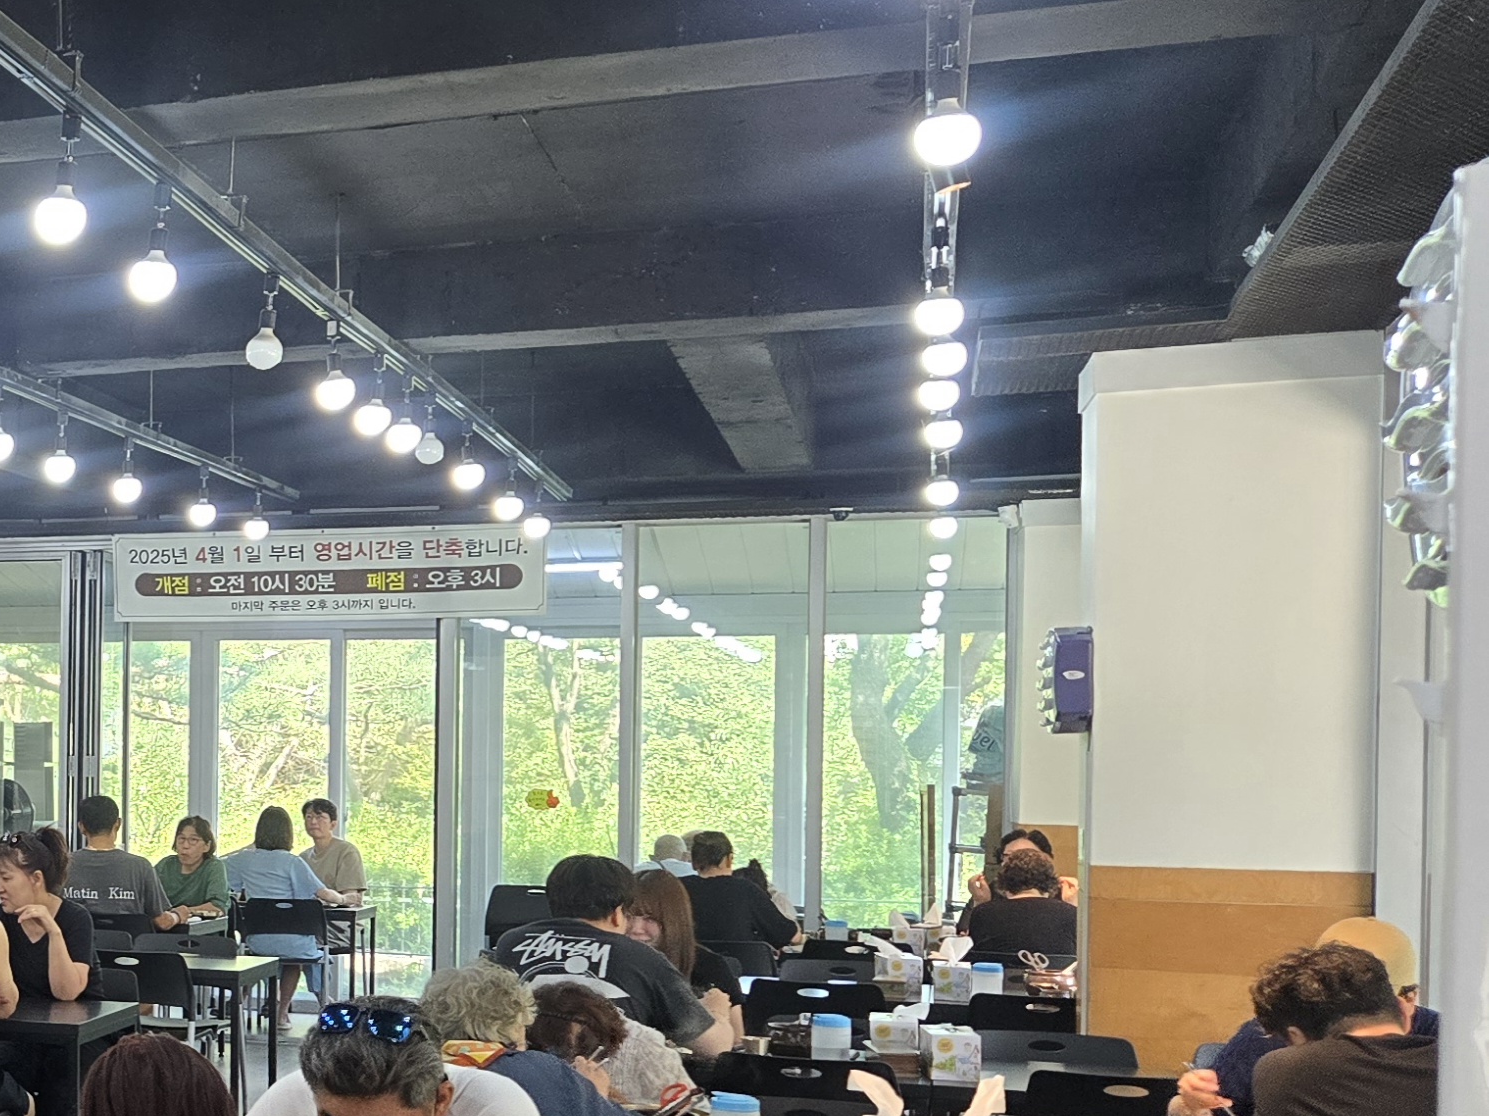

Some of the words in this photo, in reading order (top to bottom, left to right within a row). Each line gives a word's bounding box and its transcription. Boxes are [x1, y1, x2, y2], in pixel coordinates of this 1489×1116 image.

[128, 547, 188, 565] 2025년
[195, 545, 225, 564] 4월
[233, 544, 261, 563] 1일
[268, 543, 304, 563] 부터
[314, 539, 414, 562] 영업시간을
[422, 537, 529, 560] 단축합니다.
[155, 575, 190, 595] 개점
[196, 578, 202, 592] :
[208, 574, 245, 594] 오전
[251, 573, 289, 593] 10시
[294, 572, 336, 593] 30분
[366, 570, 405, 591] 폐점
[425, 569, 464, 589] 오후
[470, 567, 500, 588] 3시
[231, 600, 264, 612] 마지막
[268, 599, 302, 612] 주문은
[305, 599, 329, 611] 오후
[332, 598, 374, 611] 3시까지
[378, 597, 416, 610] 입니다.
[63, 886, 99, 900] Matin
[108, 886, 136, 900] Kim
